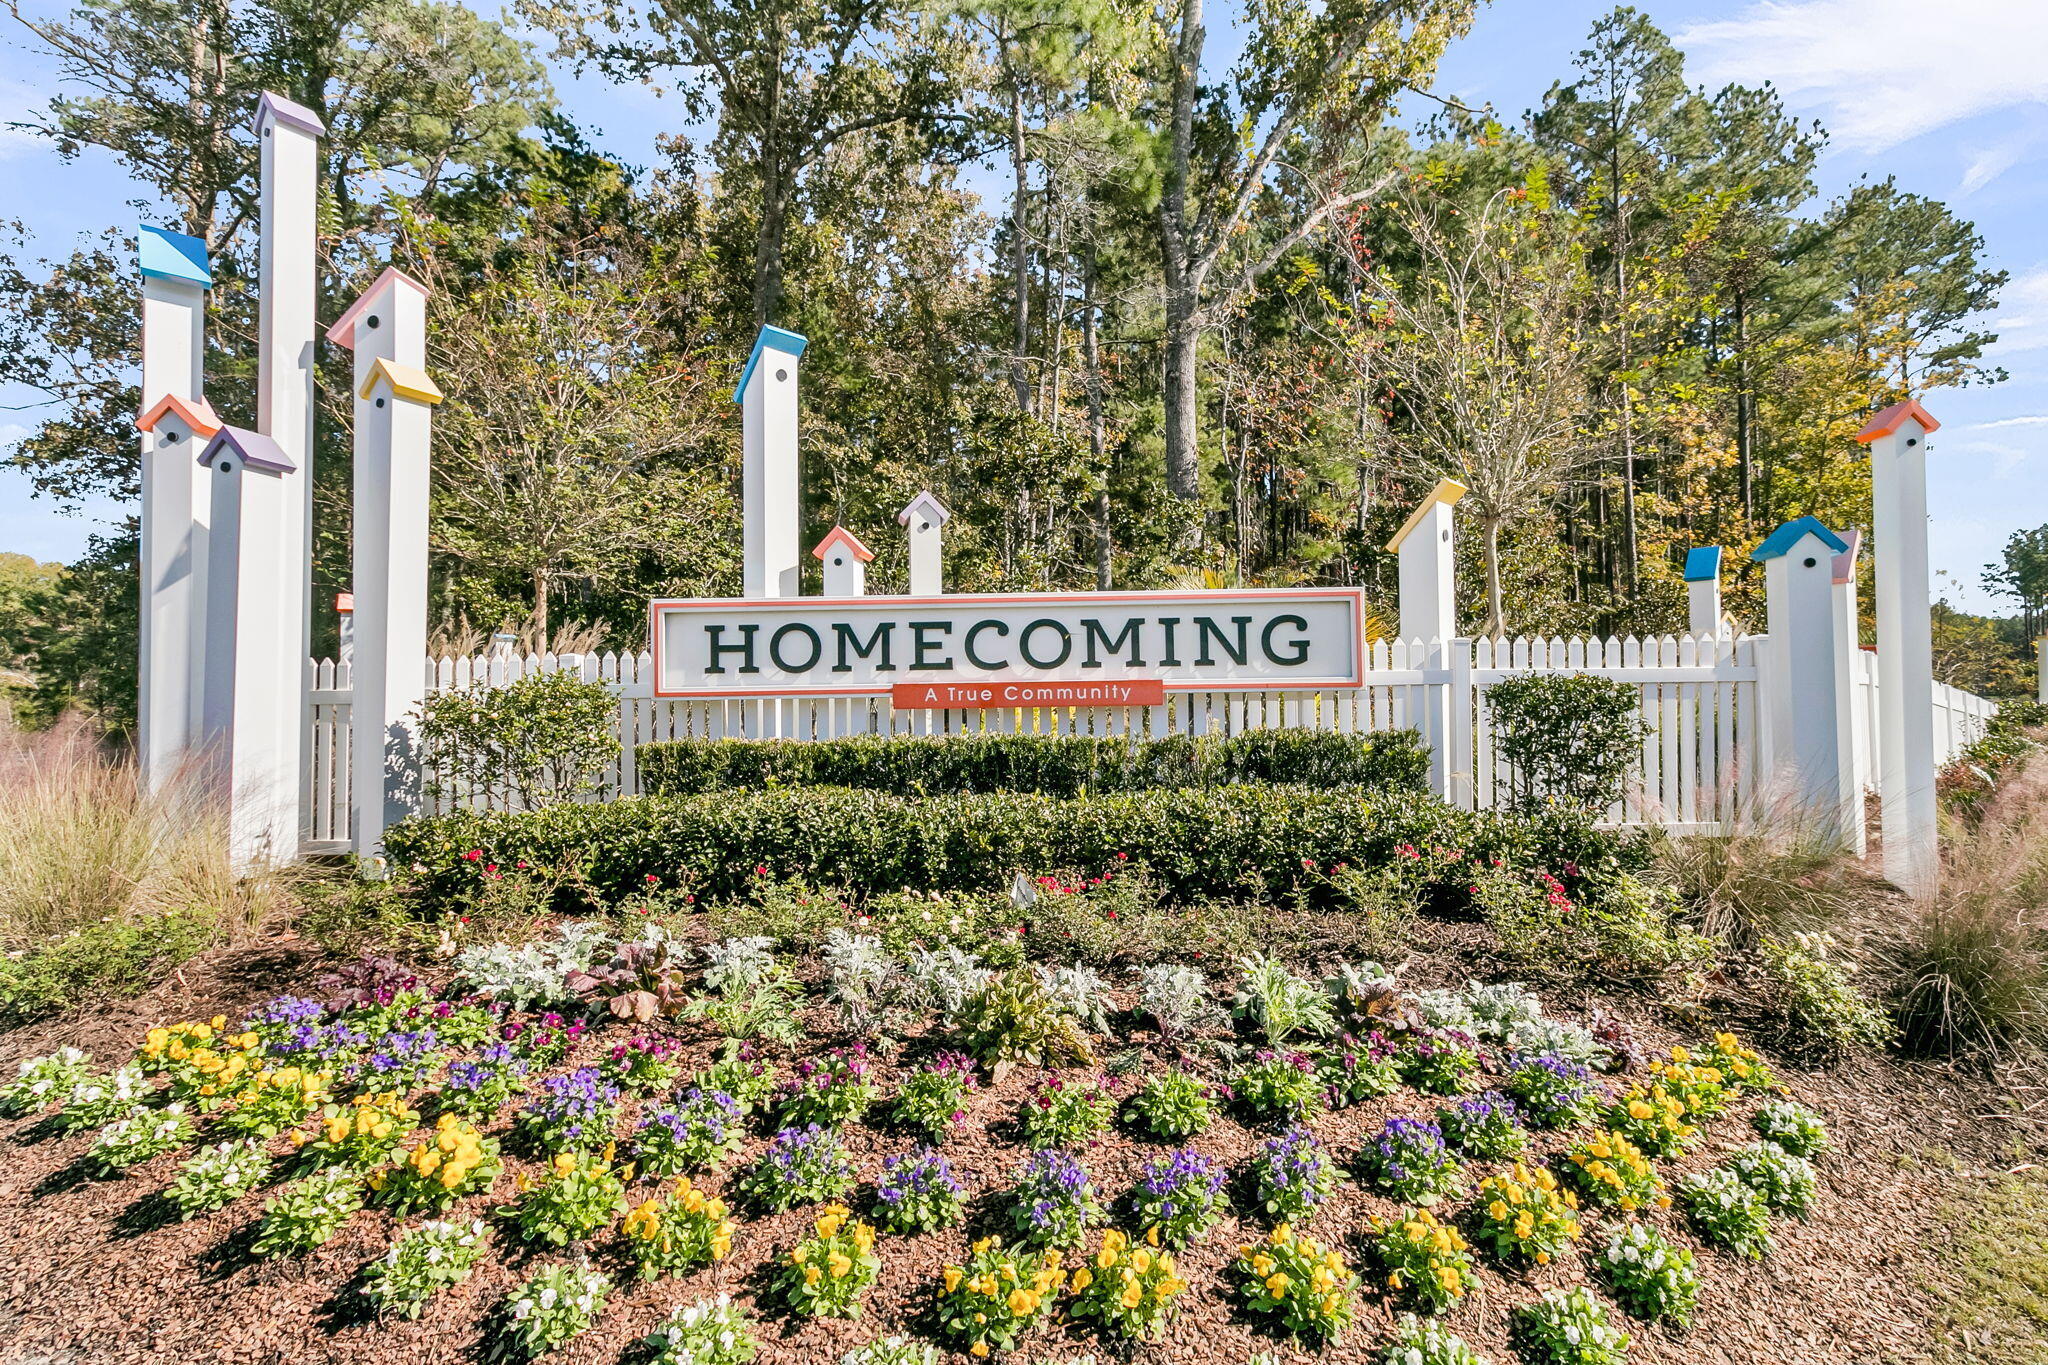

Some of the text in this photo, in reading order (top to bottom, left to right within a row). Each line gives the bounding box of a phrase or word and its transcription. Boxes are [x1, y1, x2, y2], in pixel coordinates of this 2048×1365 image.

[704, 614, 1310, 674] HOMECOMING
[925, 684, 1132, 702] A True Community
